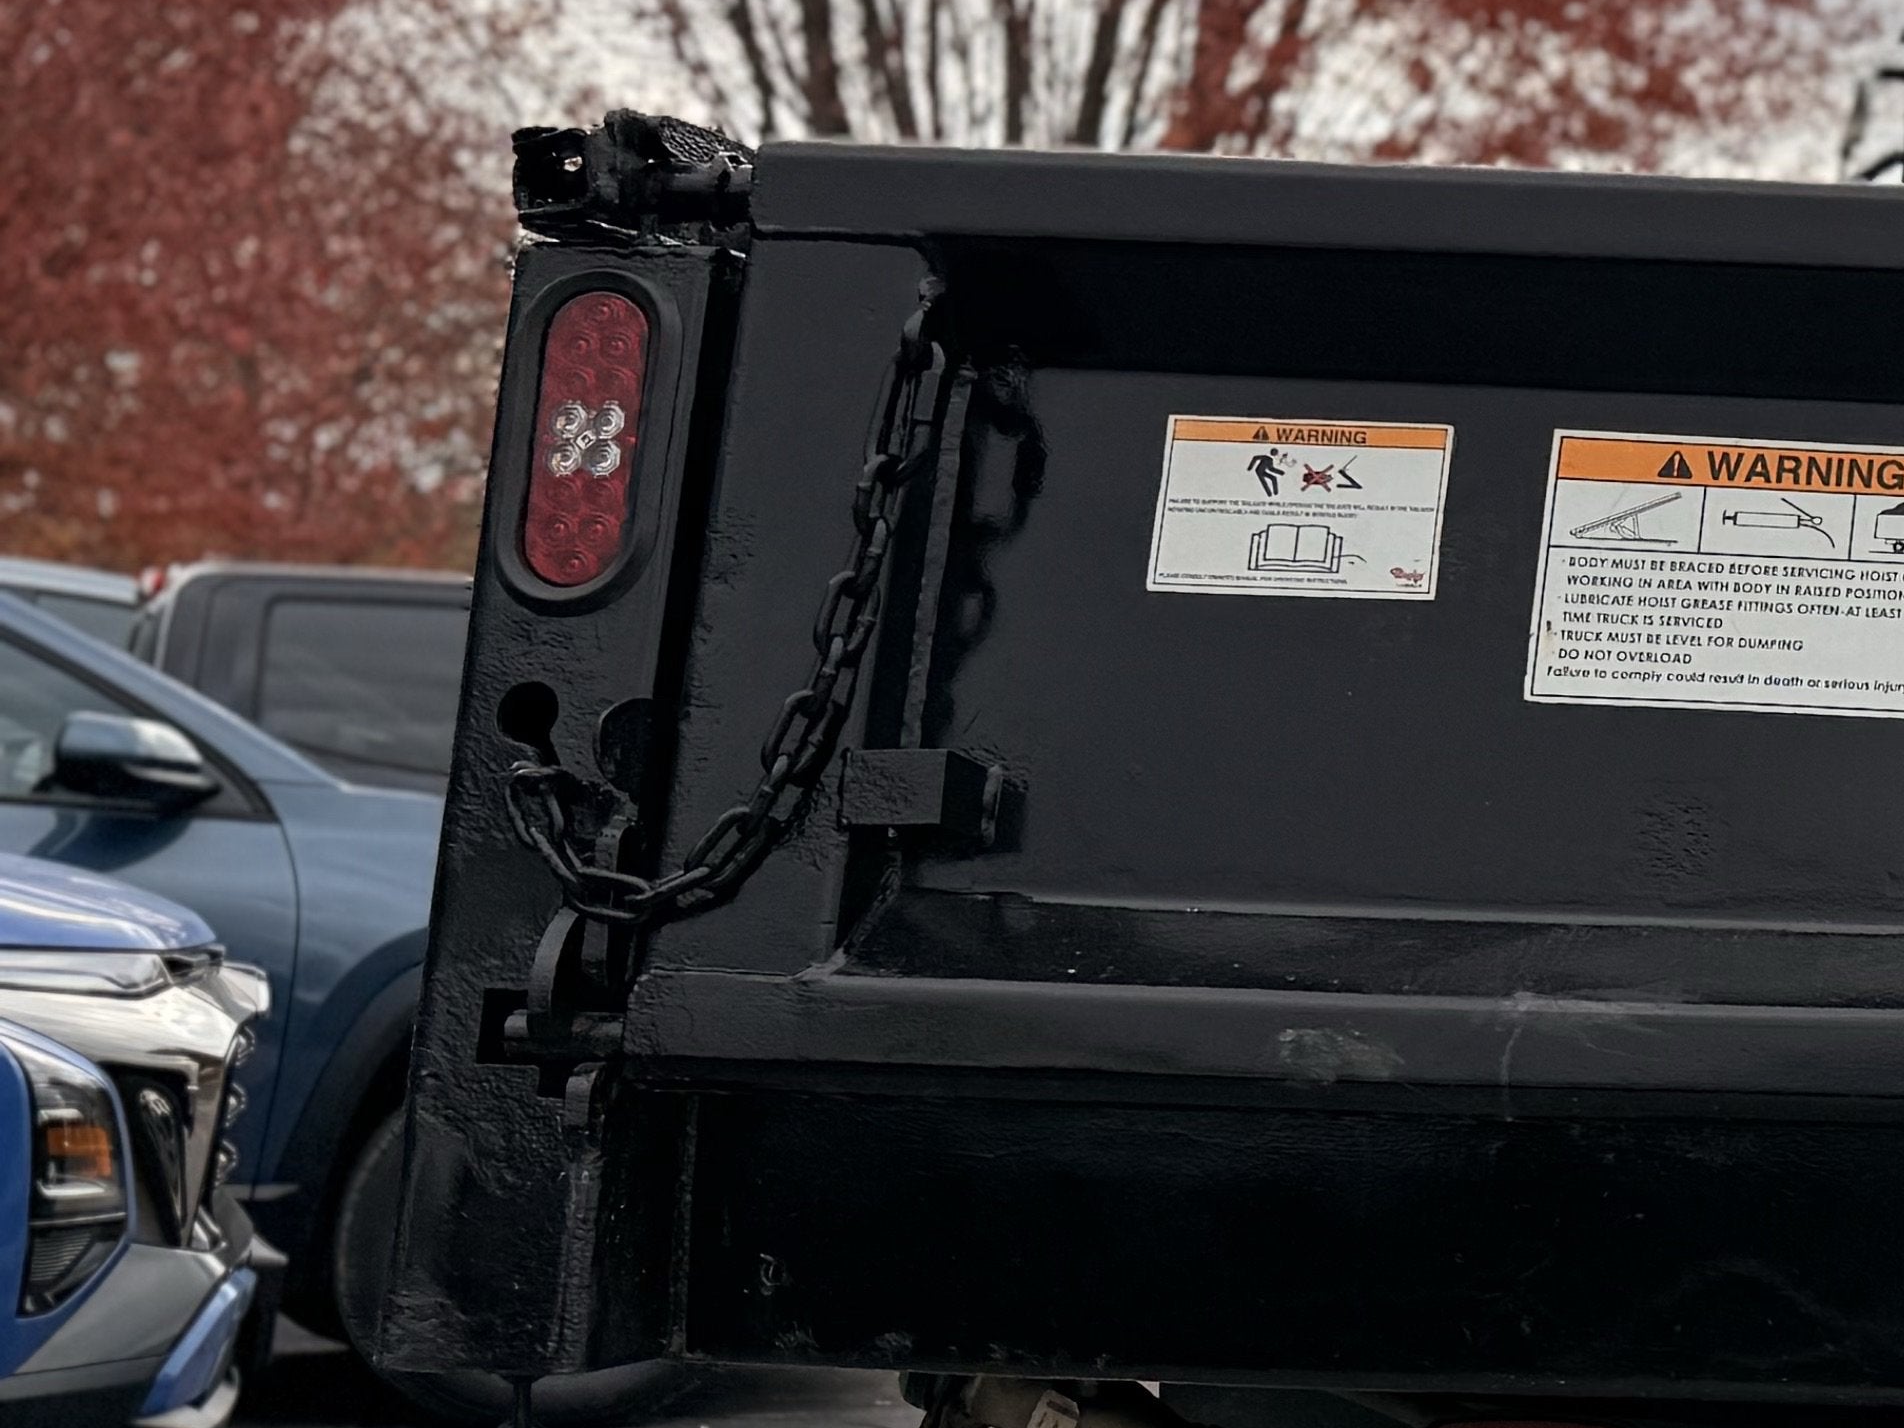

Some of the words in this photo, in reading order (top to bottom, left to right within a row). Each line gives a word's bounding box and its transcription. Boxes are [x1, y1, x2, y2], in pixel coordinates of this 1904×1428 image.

[1275, 427, 1368, 445] WARNING
[1569, 557, 1608, 567] BODY
[1611, 559, 1645, 570] MUST
[1651, 560, 1665, 571] BE
[1670, 561, 1724, 573] BRACED
[1729, 563, 1778, 576] BEFORE
[1782, 566, 1855, 580] SERVICING
[1860, 571, 1898, 582] HOIST
[1568, 575, 1633, 588] WORKING
[1639, 578, 1652, 588] IN
[1657, 579, 1692, 590] AREA
[1698, 581, 1728, 591] WITH
[1733, 582, 1772, 594] BODY
[1776, 584, 1790, 594] IN
[1795, 585, 1841, 597] RAISED
[1565, 593, 1633, 606] LUBRICATE
[1638, 596, 1676, 607] HOIST
[1681, 599, 1733, 610] GREASE
[1738, 601, 1792, 613] FITTINGS
[1865, 608, 1901, 618] LEAST
[1564, 611, 1591, 623] TIME
[1597, 613, 1638, 625] TRUCK
[1643, 615, 1653, 625] IS
[1660, 615, 1722, 628] SERVICED
[1561, 630, 1602, 642] TRUCK
[1607, 632, 1641, 643] MUST
[1647, 634, 1661, 645] BE
[1666, 635, 1702, 646] LEVEL
[1707, 636, 1734, 647] FOR
[1738, 638, 1803, 651] DUMPING
[1559, 648, 1579, 659] DO
[1584, 650, 1612, 660] NOT
[1617, 651, 1691, 664] OVERLOAD
[1595, 669, 1607, 678] to
[1612, 671, 1662, 682] comply
[1667, 672, 1705, 682] could
[1748, 674, 1759, 684] in
[1764, 675, 1803, 686] death
[1807, 679, 1820, 687] or
[1825, 679, 1869, 690] serious
